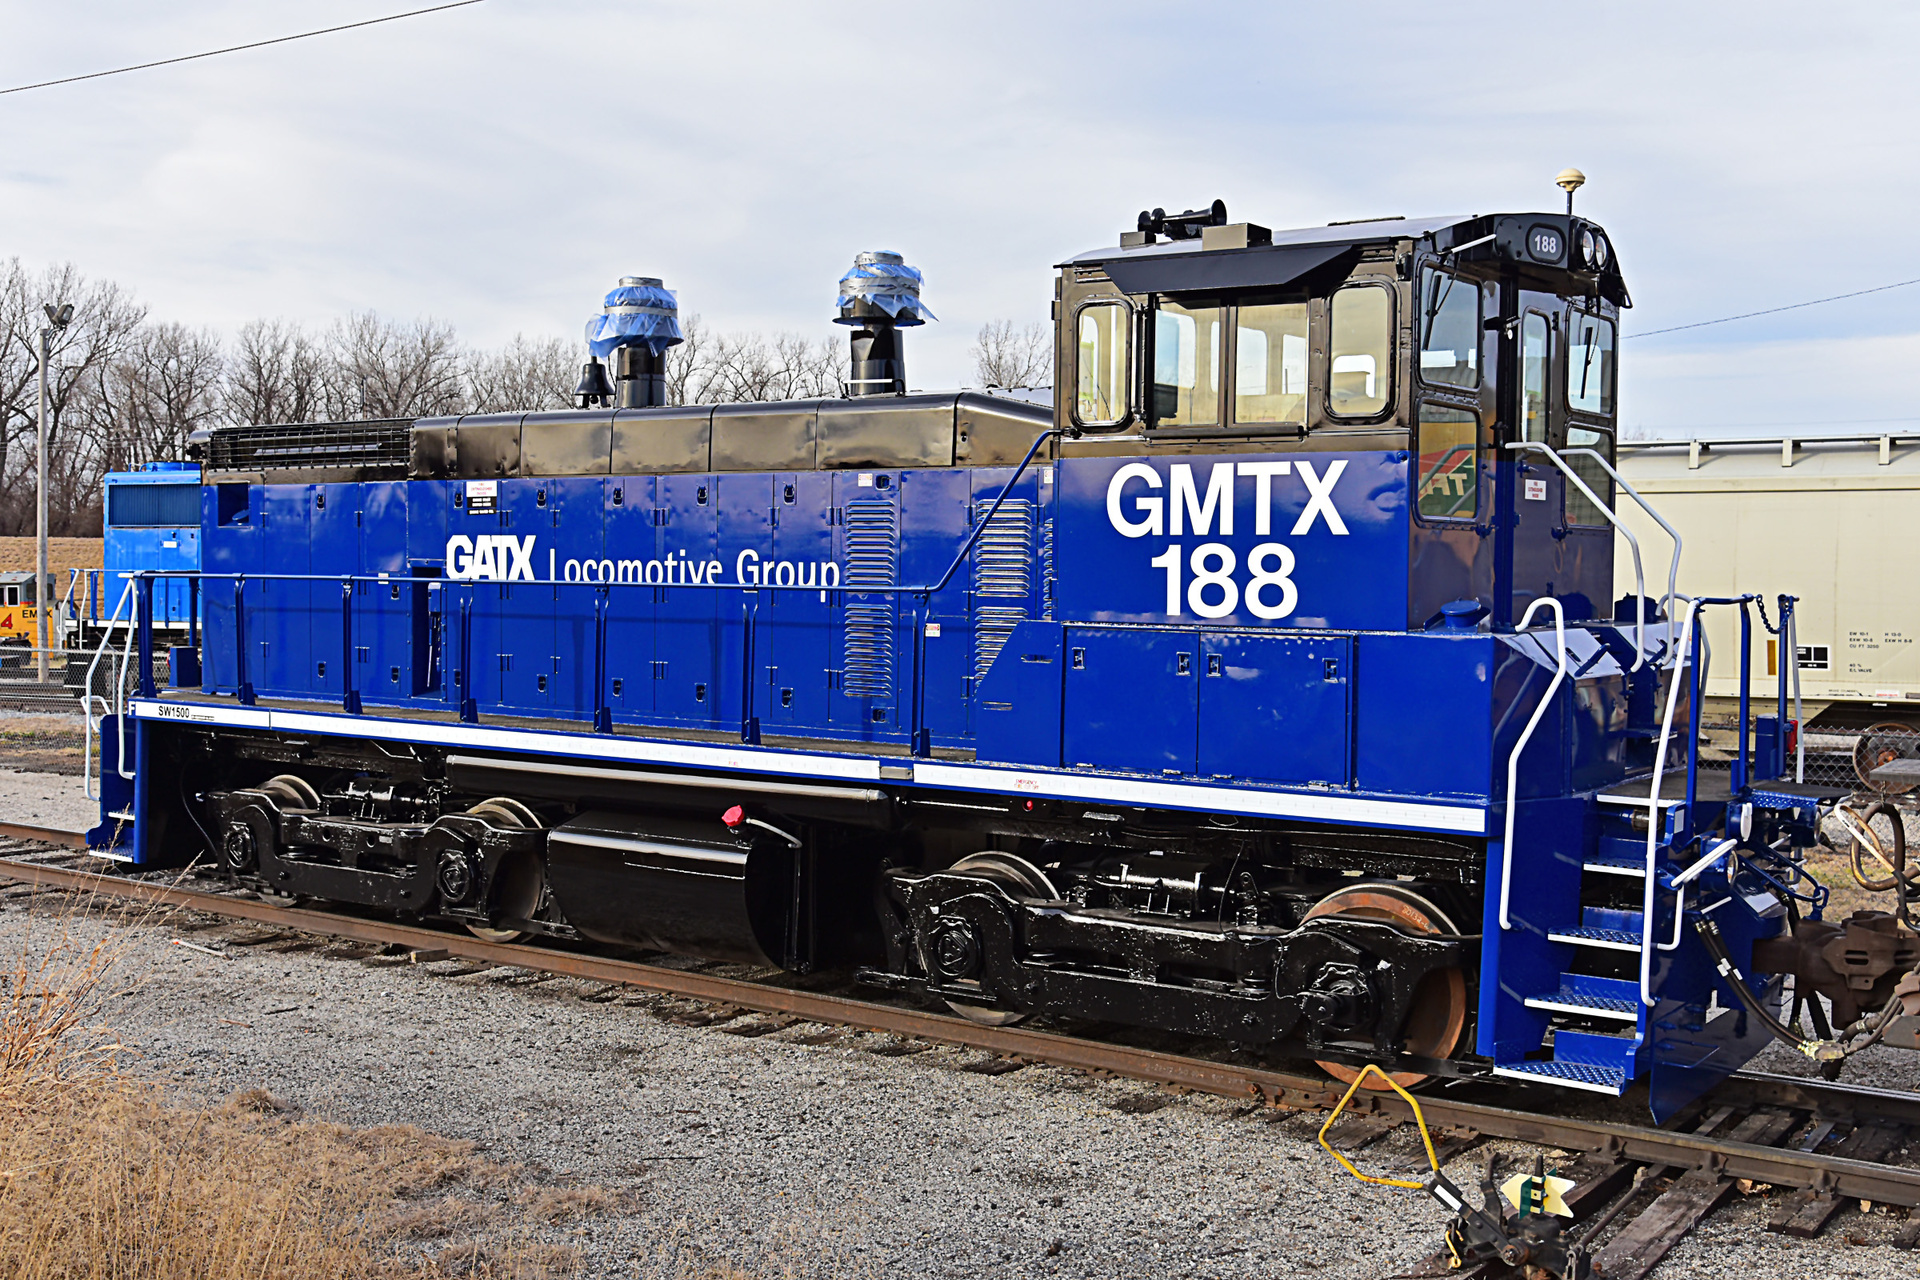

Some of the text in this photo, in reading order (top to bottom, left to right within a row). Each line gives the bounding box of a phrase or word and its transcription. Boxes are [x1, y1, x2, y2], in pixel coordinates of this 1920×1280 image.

[1534, 234, 1557, 254] 188
[1106, 460, 1350, 538] GMTX
[445, 534, 841, 603] GATX Locomotive Group
[1151, 542, 1298, 620] 188
[0, 613, 13, 630] 4
[22, 609, 53, 619] EMX
[128, 700, 136, 716] F
[158, 705, 190, 719] SW1500
